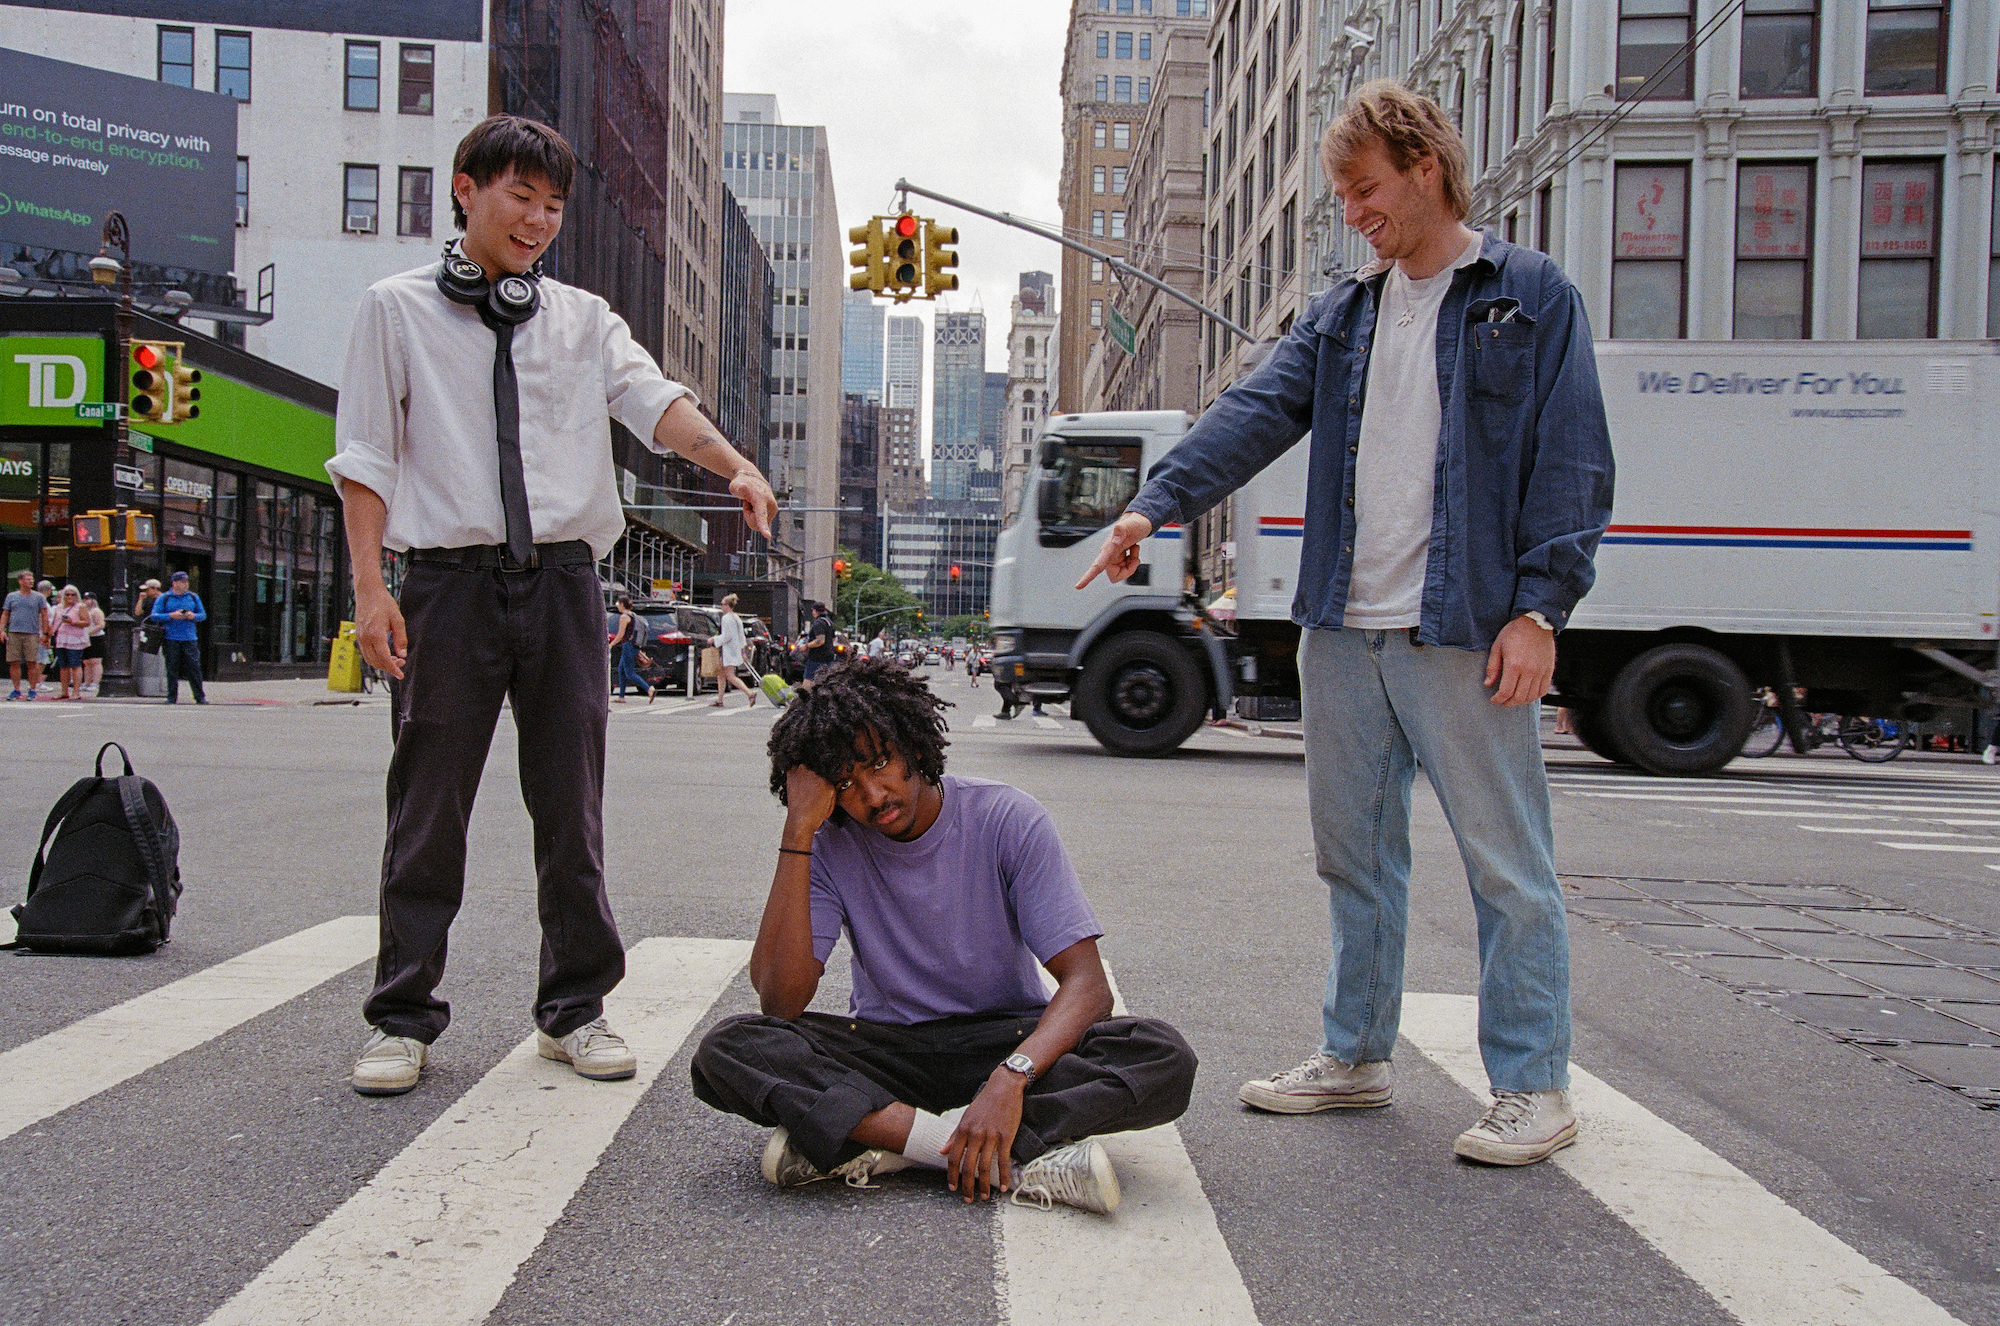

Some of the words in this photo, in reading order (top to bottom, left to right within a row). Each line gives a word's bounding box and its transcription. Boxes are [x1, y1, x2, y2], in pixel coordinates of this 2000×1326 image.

[32, 108, 57, 124] on
[62, 111, 102, 133] total
[106, 123, 170, 149] privacy
[175, 135, 210, 153] with
[2, 123, 104, 152] end-to-end
[108, 143, 204, 170] encryption.
[53, 154, 109, 175] privately
[15, 199, 92, 226] WhatsApp
[14, 354, 87, 408] TD
[1638, 371, 1684, 394] We
[1687, 372, 1790, 394] Deliver
[1793, 372, 1843, 394] For
[79, 404, 104, 418] Canal
[0, 460, 33, 476] AYS
[167, 476, 188, 493] OPEN
[194, 482, 213, 499] DAYS
